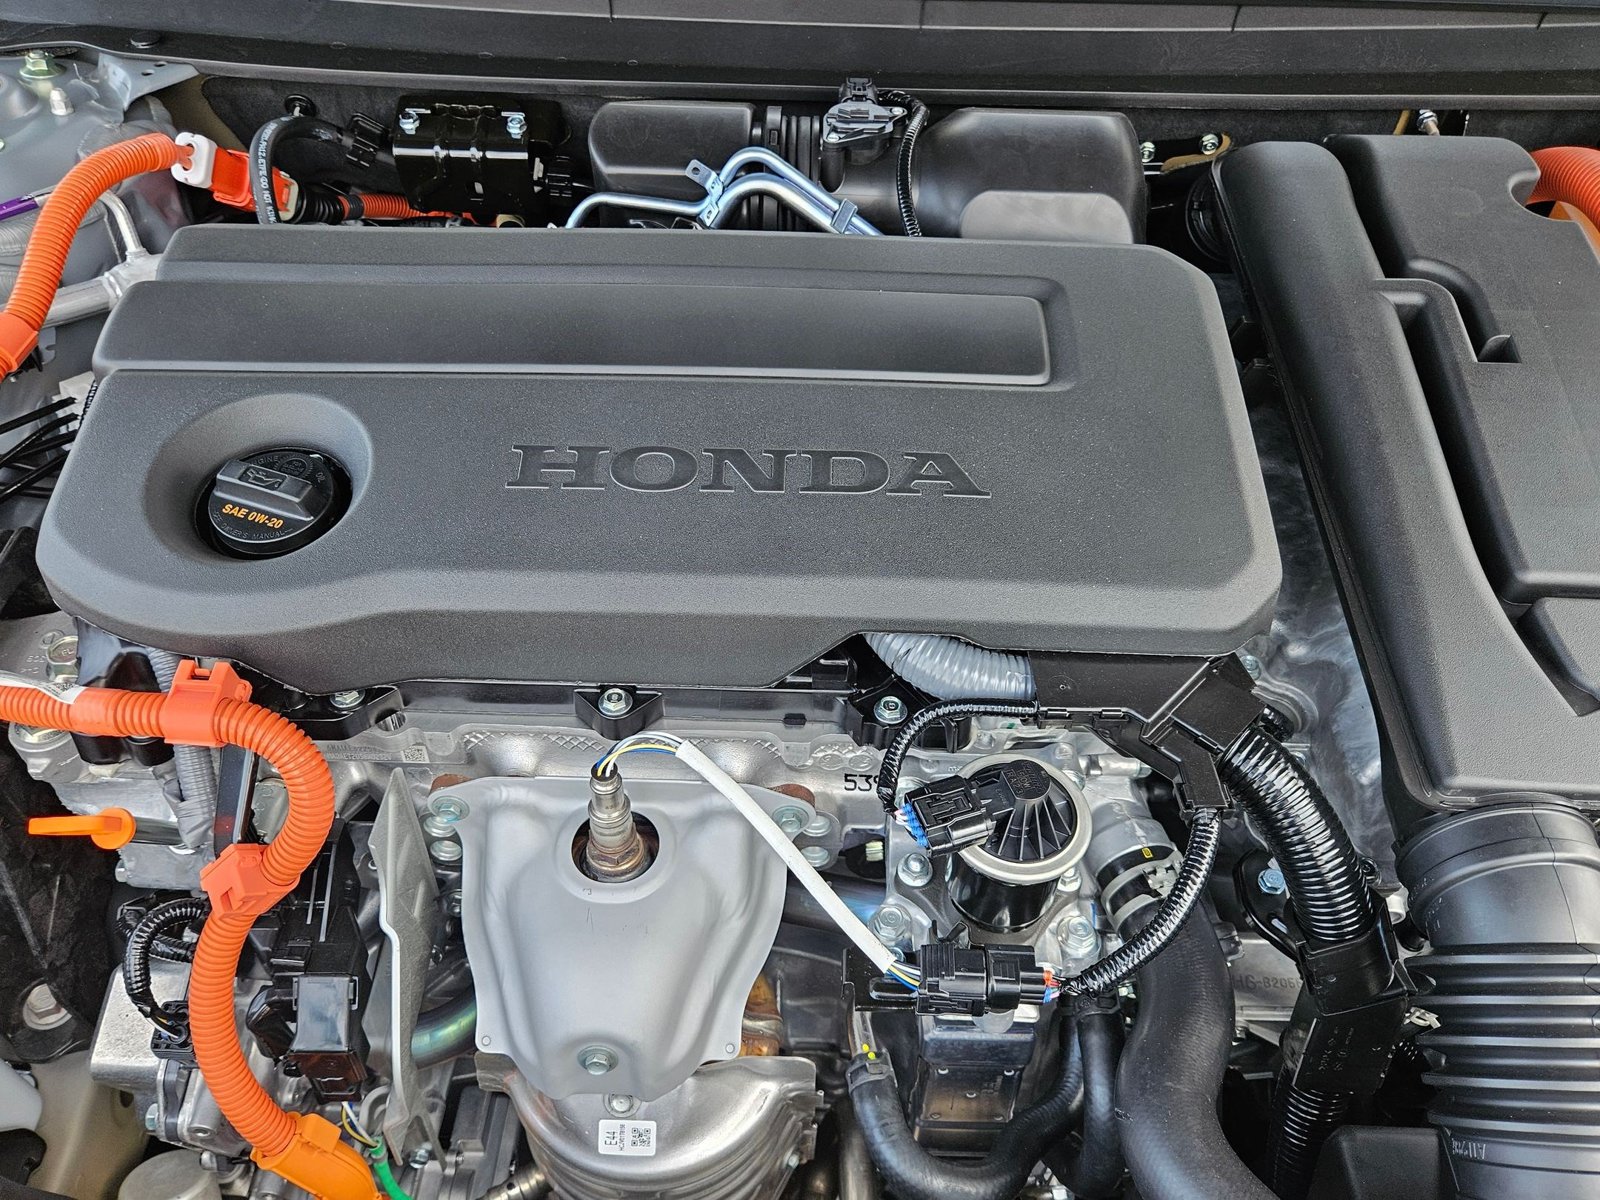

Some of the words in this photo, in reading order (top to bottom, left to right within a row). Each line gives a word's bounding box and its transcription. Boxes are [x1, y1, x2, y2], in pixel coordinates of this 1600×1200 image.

[504, 444, 992, 499] HONDA
[222, 504, 249, 519] SAE
[247, 511, 284, 529] 0W-20
[251, 529, 285, 540] MANUAL
[604, 1131, 618, 1145] E44
